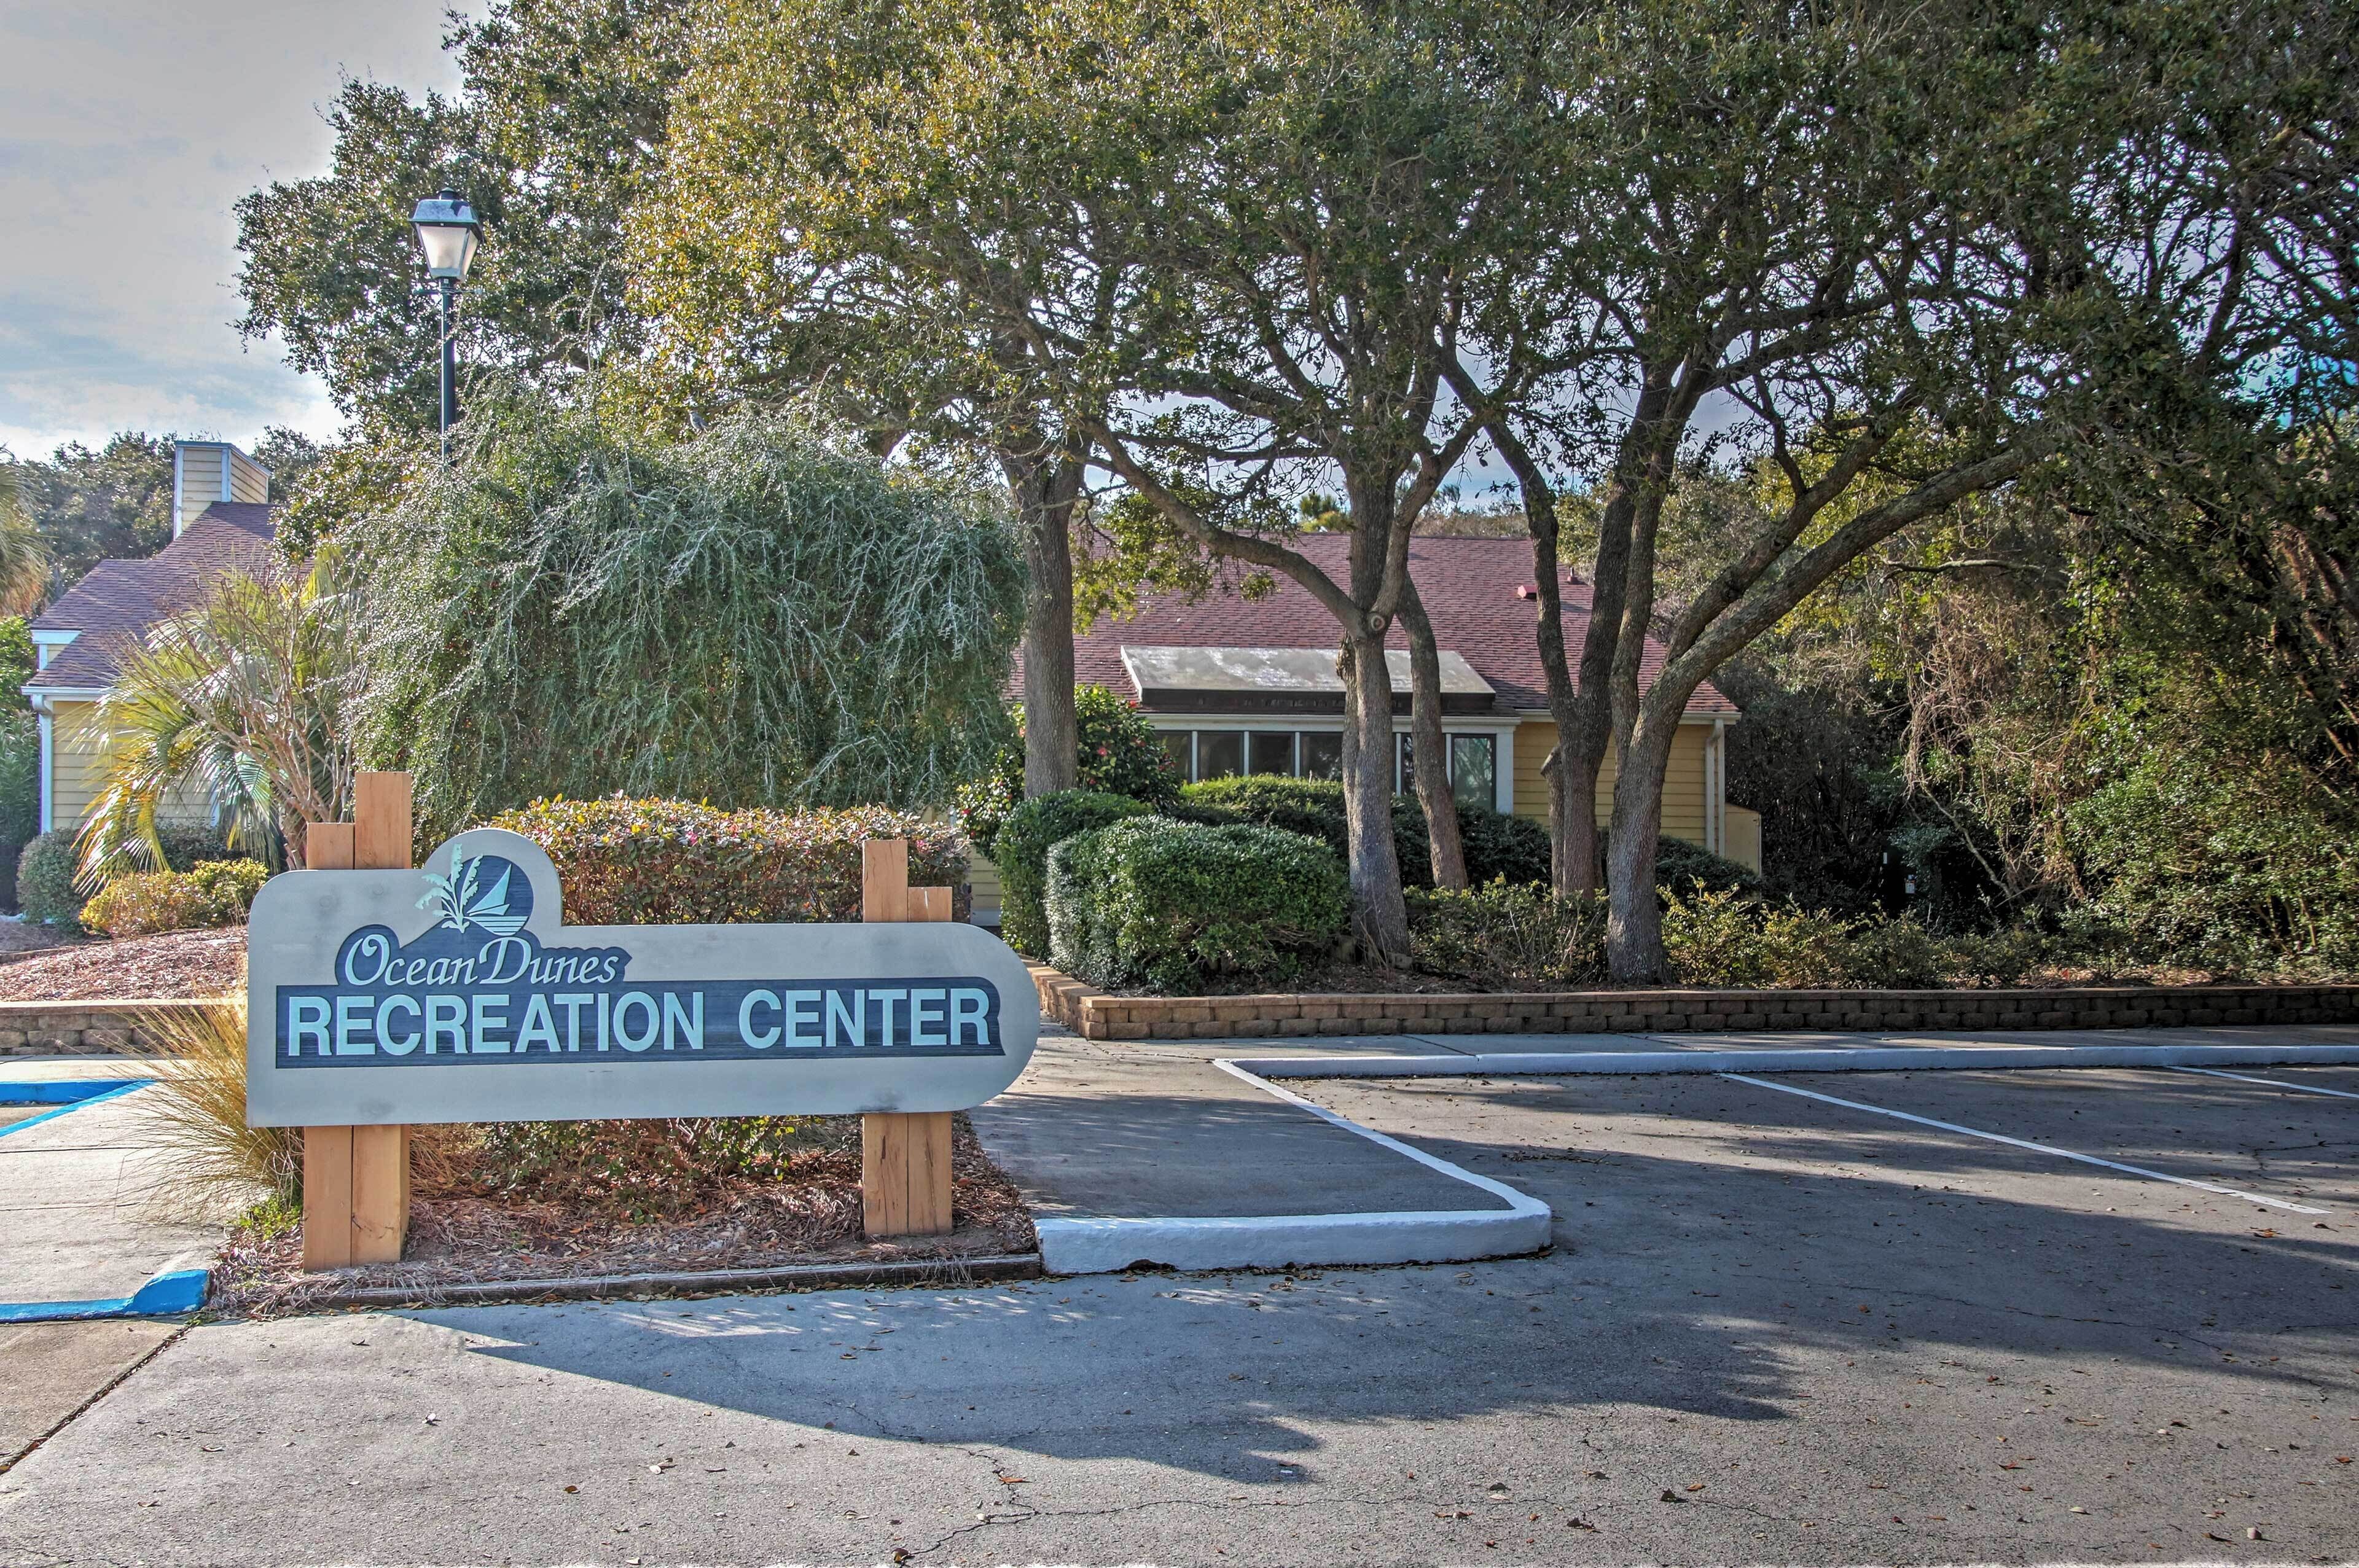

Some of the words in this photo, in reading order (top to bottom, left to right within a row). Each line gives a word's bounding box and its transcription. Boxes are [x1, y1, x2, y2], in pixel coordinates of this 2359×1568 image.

[345, 934, 479, 986] Ocean
[478, 935, 619, 985] Dunes
[288, 991, 705, 1057] RECREATION
[738, 988, 991, 1049] CENTER
